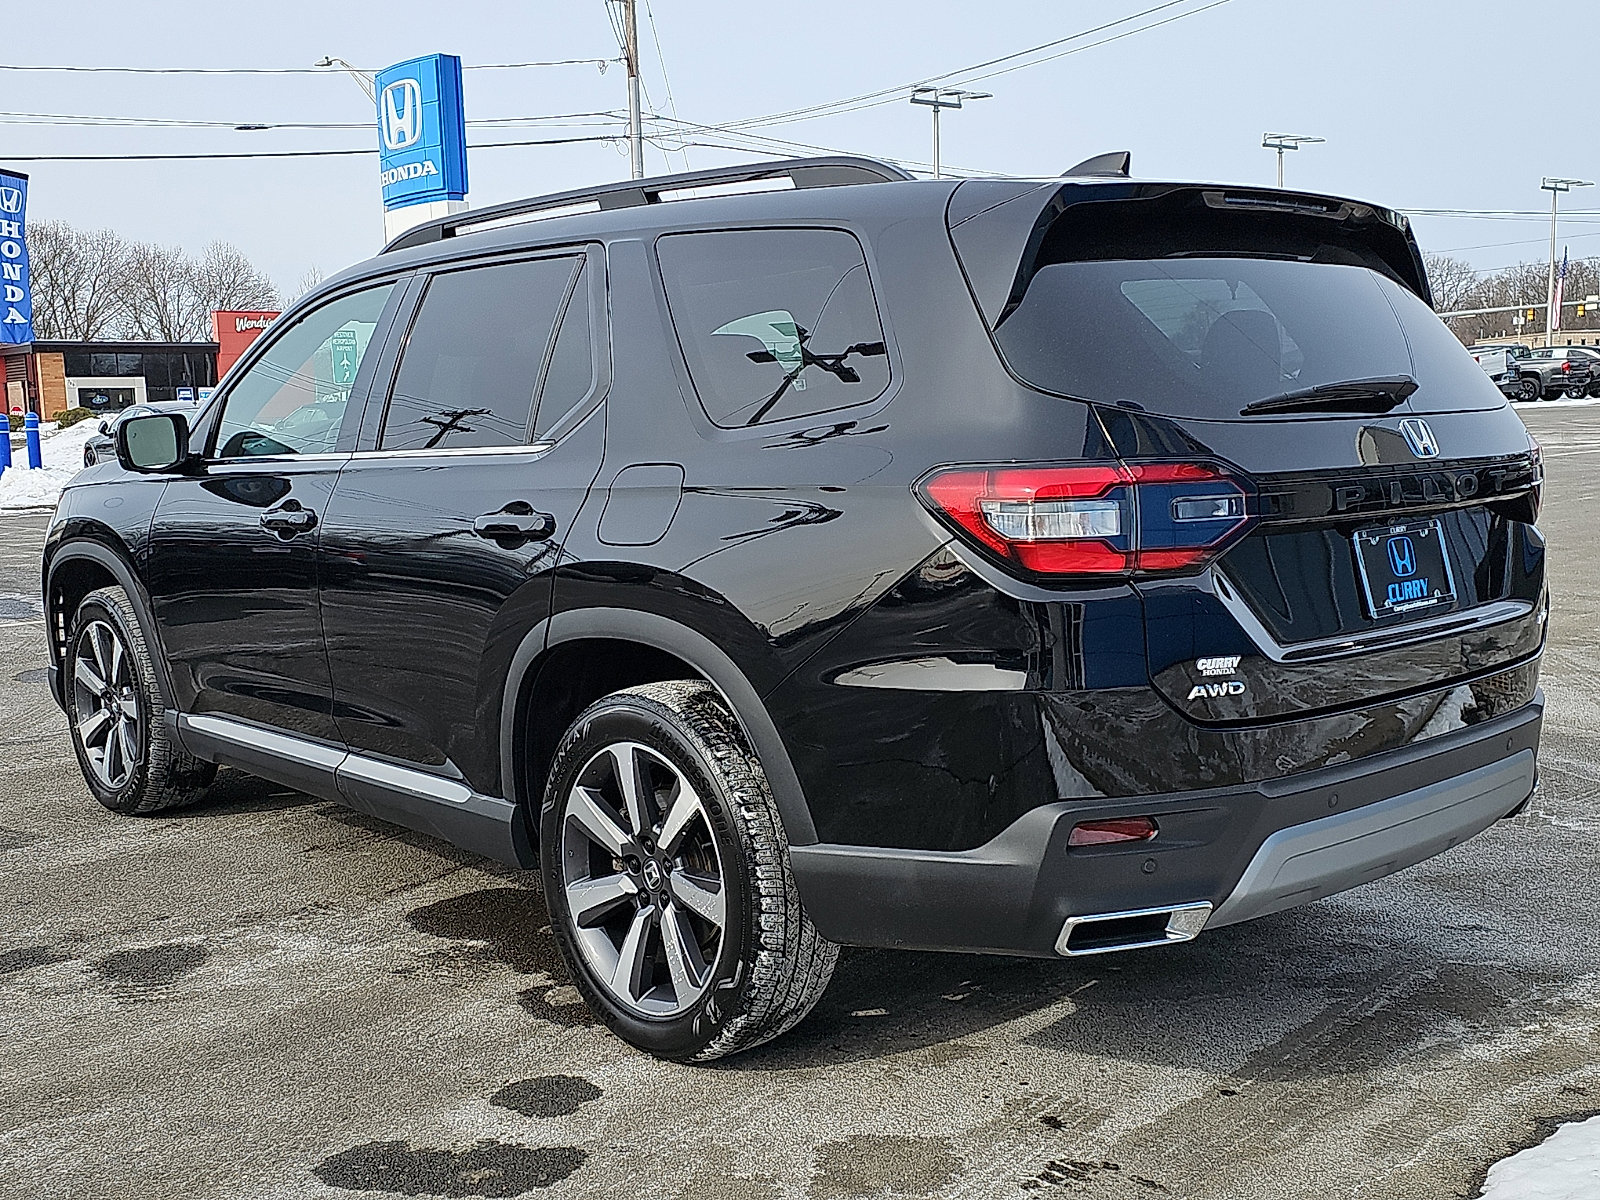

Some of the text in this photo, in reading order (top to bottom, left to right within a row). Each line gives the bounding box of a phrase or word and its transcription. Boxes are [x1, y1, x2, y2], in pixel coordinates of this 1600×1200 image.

[381, 160, 438, 187] HONDA
[0, 220, 28, 324] HONDA
[1336, 470, 1506, 511] PILOT
[1388, 578, 1428, 603] CURRY
[1197, 656, 1241, 670] CURRY
[1202, 668, 1236, 676] HONDA
[1187, 681, 1246, 700] AWD
